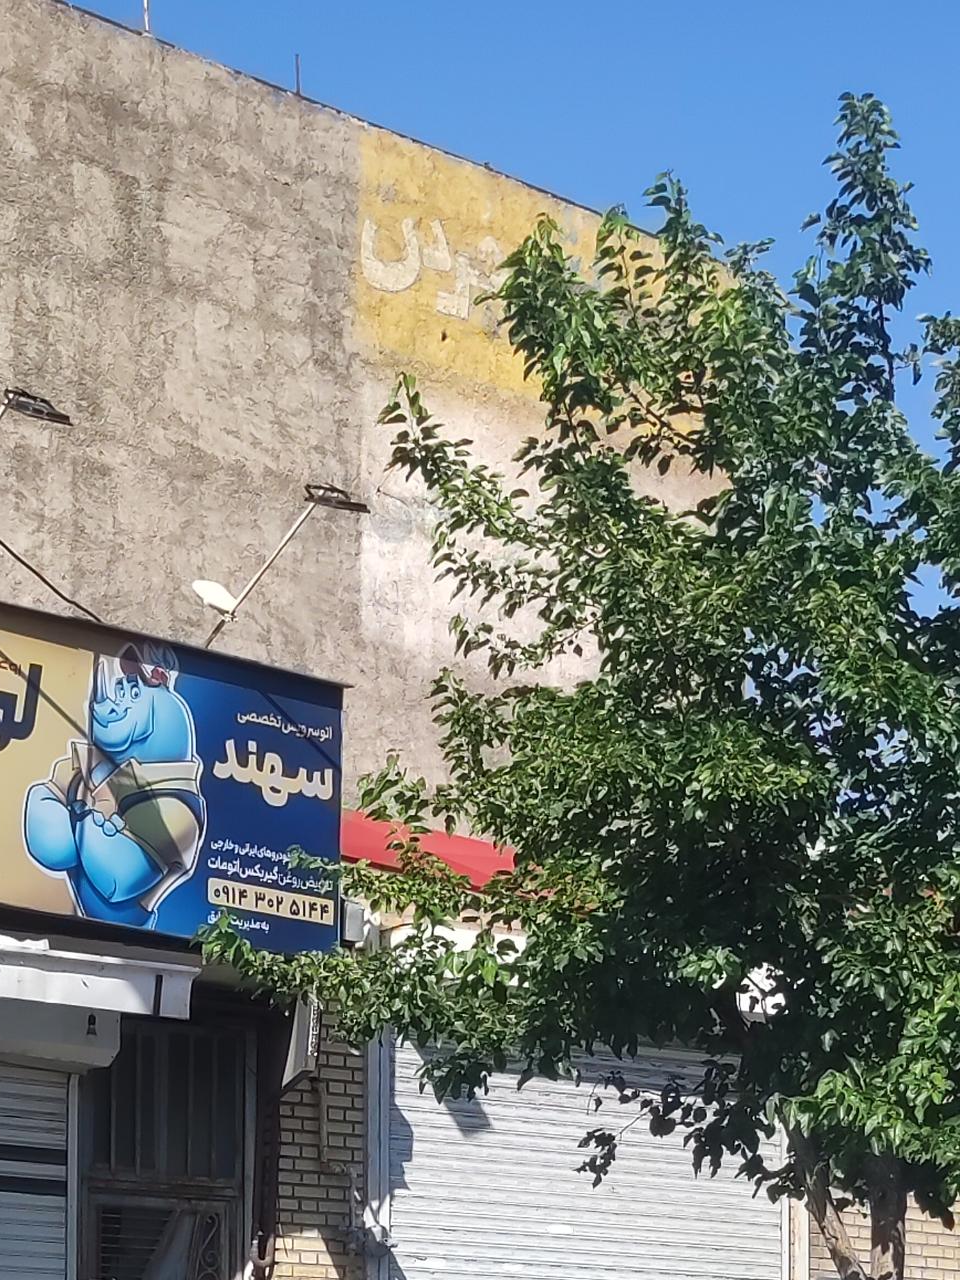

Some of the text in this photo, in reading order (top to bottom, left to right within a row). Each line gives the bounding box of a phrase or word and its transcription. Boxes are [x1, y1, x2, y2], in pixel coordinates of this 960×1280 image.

[237, 712, 282, 728] تخصصی
[213, 738, 333, 805] سهند
[208, 856, 240, 876] اتومات
[214, 885, 330, 920] ۰۹۱۴ ۳۰۲ ۵۱۴۴
[230, 914, 261, 931] مدیریت
